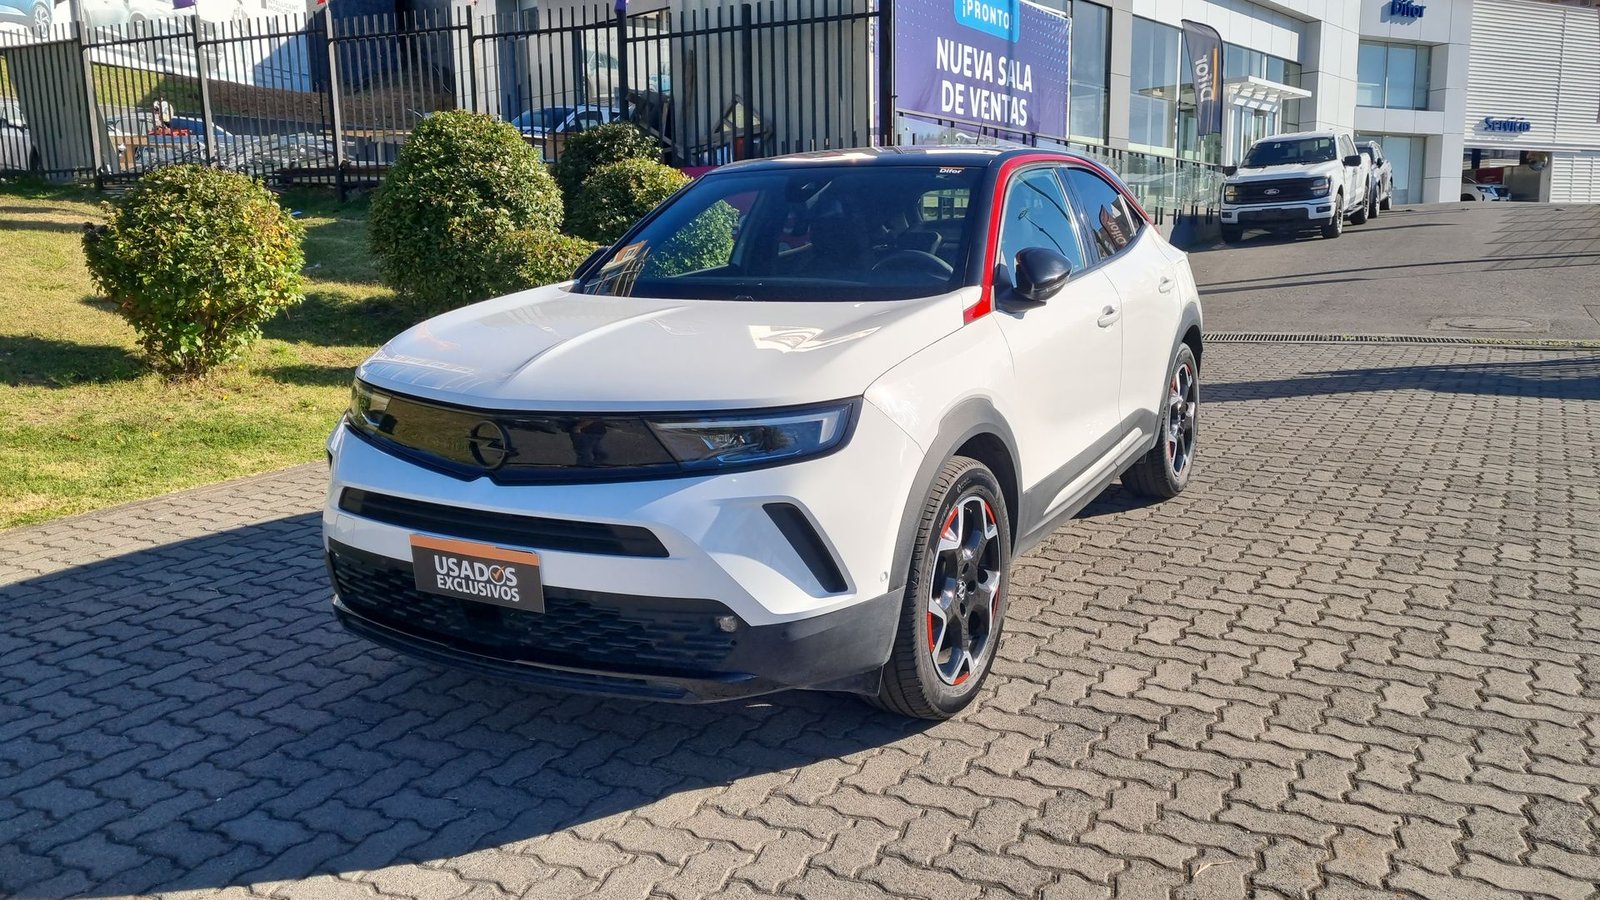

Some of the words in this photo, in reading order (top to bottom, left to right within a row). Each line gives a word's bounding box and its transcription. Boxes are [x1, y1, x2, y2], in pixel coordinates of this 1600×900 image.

[936, 36, 993, 83] NUEVA
[997, 56, 1033, 93] SALA
[941, 80, 965, 115] DE
[969, 86, 1028, 127] VENTAS
[1484, 115, 1531, 132] Servicio
[434, 554, 518, 586] USADOS
[436, 574, 520, 602] EXCLUSIVOS
